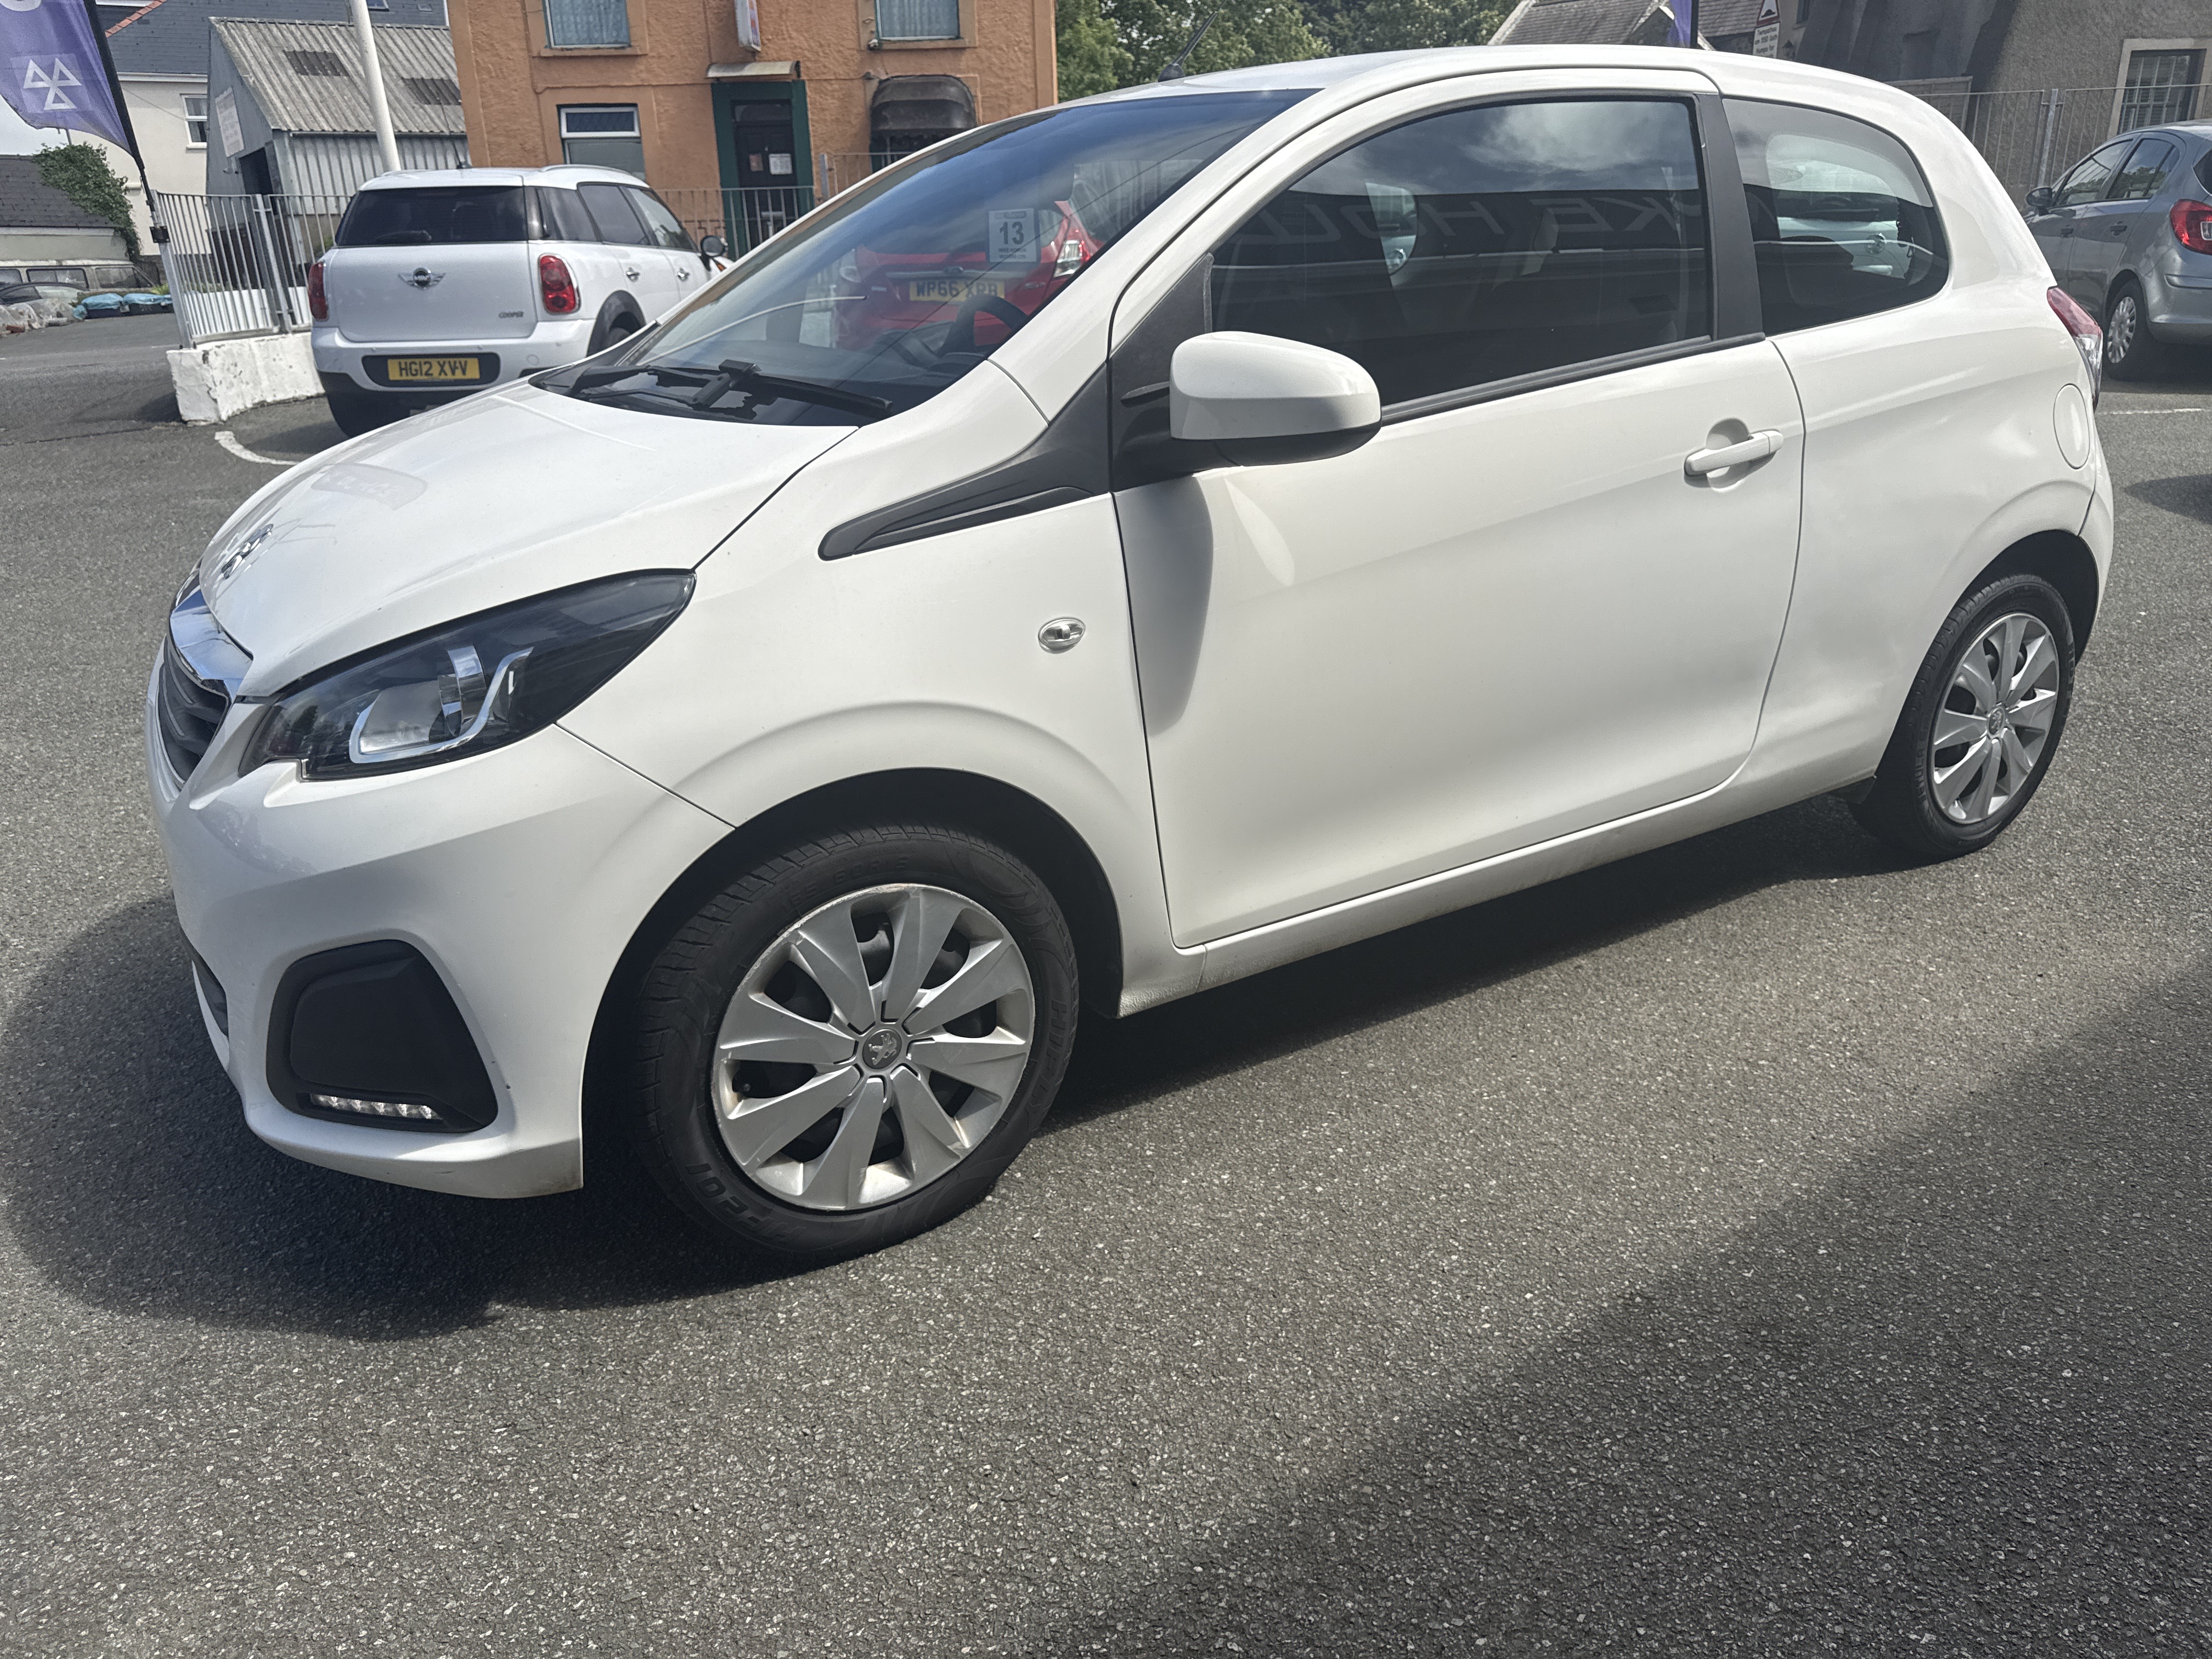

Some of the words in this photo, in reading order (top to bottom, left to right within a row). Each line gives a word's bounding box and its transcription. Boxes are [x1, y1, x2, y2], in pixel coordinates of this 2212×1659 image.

[1000, 221, 1024, 245] 13
[398, 361, 433, 377] HG12
[437, 360, 468, 376] XVV
